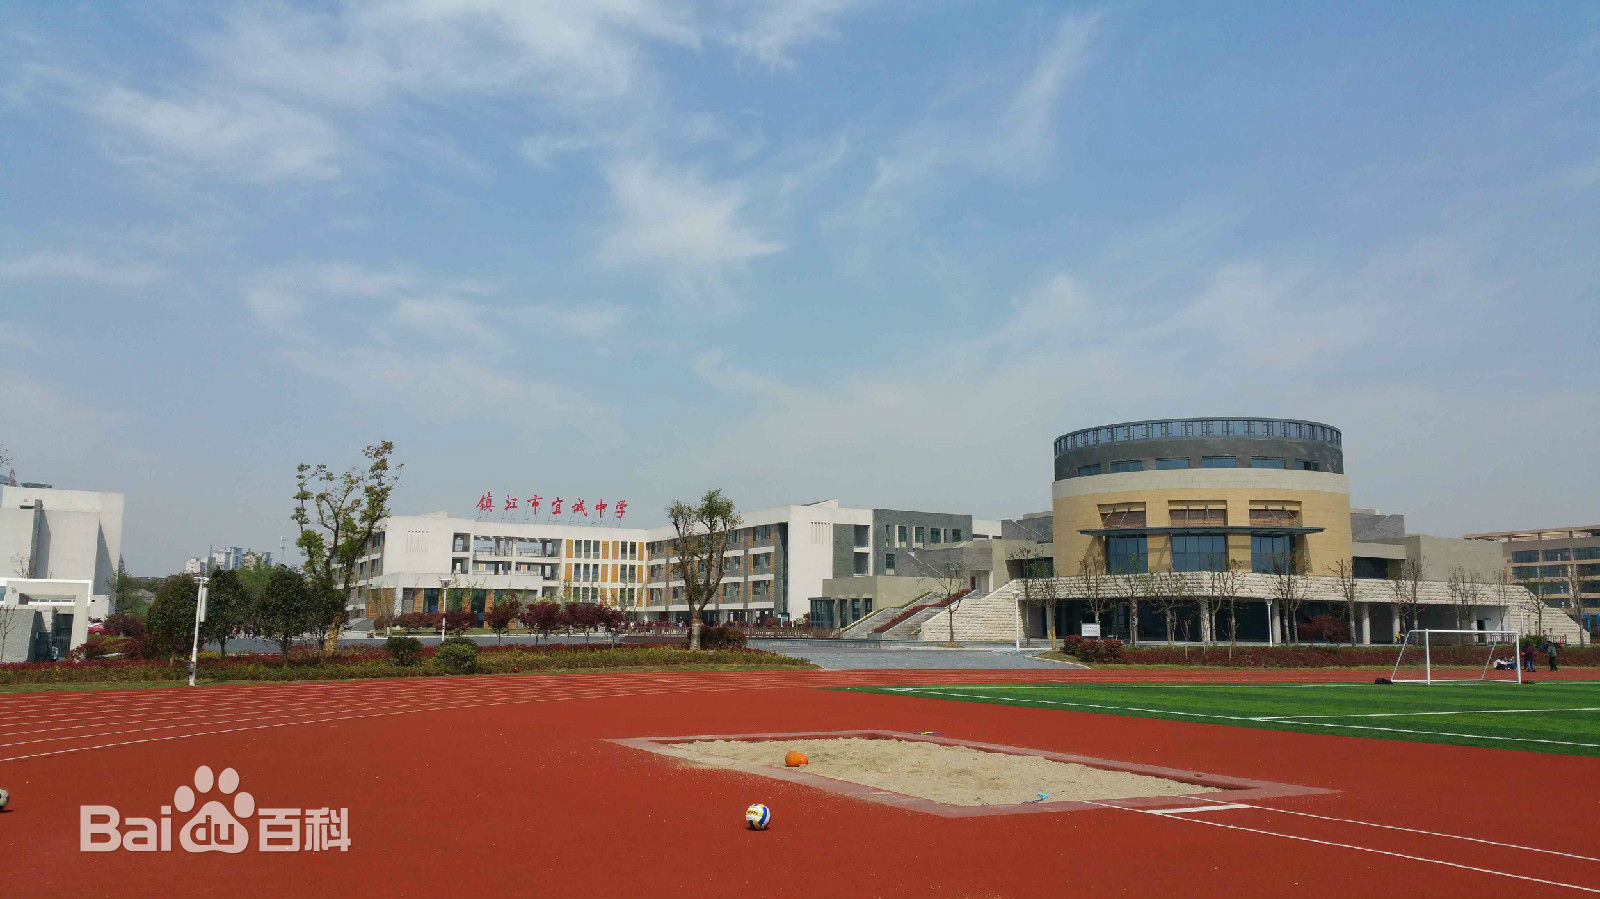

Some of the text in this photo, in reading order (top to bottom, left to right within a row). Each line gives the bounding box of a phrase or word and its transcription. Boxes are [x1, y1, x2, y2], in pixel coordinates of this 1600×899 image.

[476, 492, 628, 519] 镇江市宜城中学
